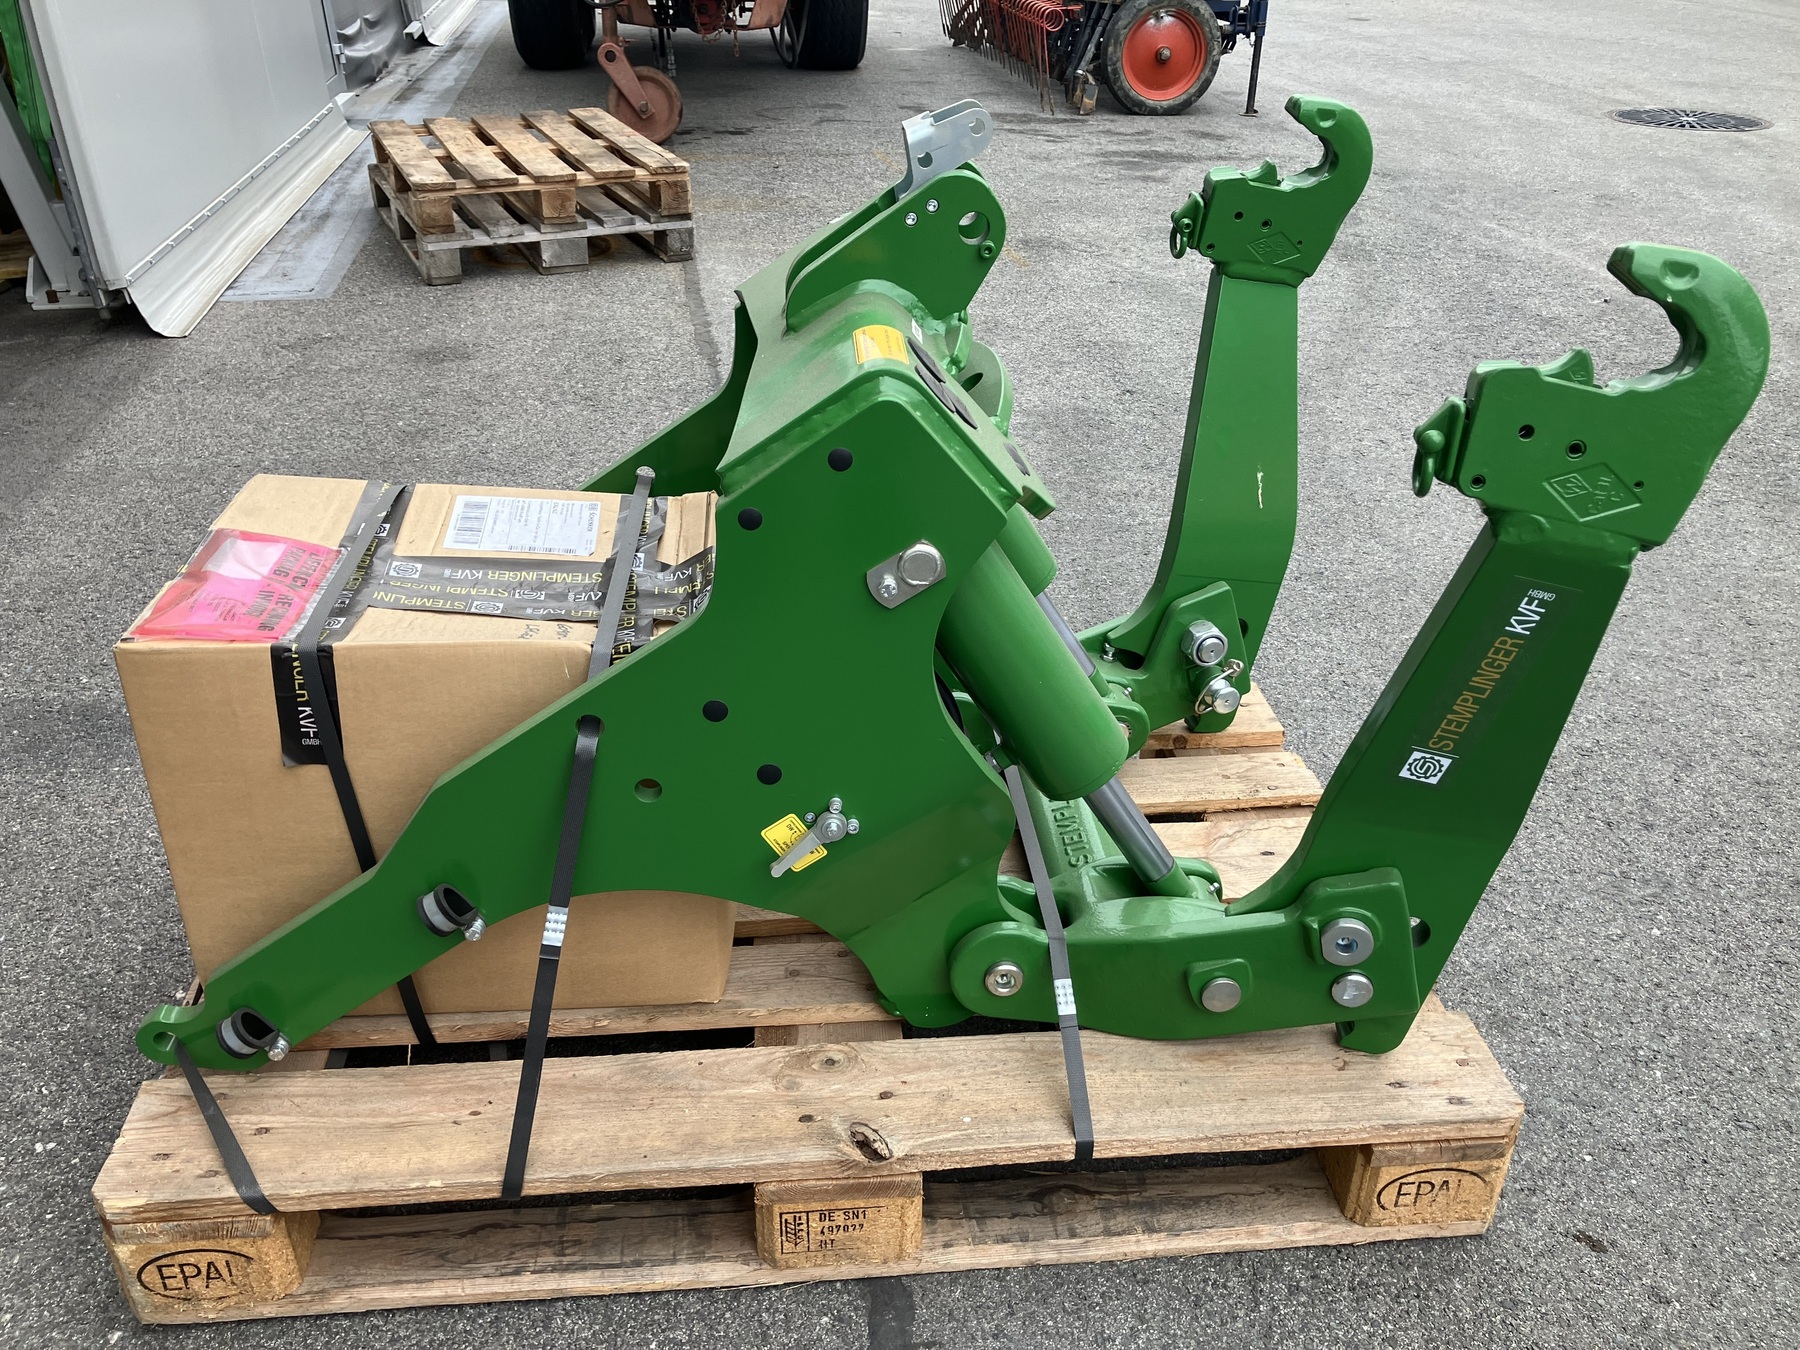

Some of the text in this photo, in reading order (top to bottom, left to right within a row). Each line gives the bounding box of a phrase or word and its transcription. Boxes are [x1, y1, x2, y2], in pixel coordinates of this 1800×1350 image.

[451, 569, 483, 580] KVF
[488, 570, 603, 584] STEMPLINGER
[1428, 588, 1556, 751] STEMPLINGER KVF GMBH
[1048, 798, 1095, 869] STEMPL
[1393, 1178, 1469, 1209] EPAL
[818, 1238, 836, 1250] HT
[156, 1260, 237, 1292] EPAL
